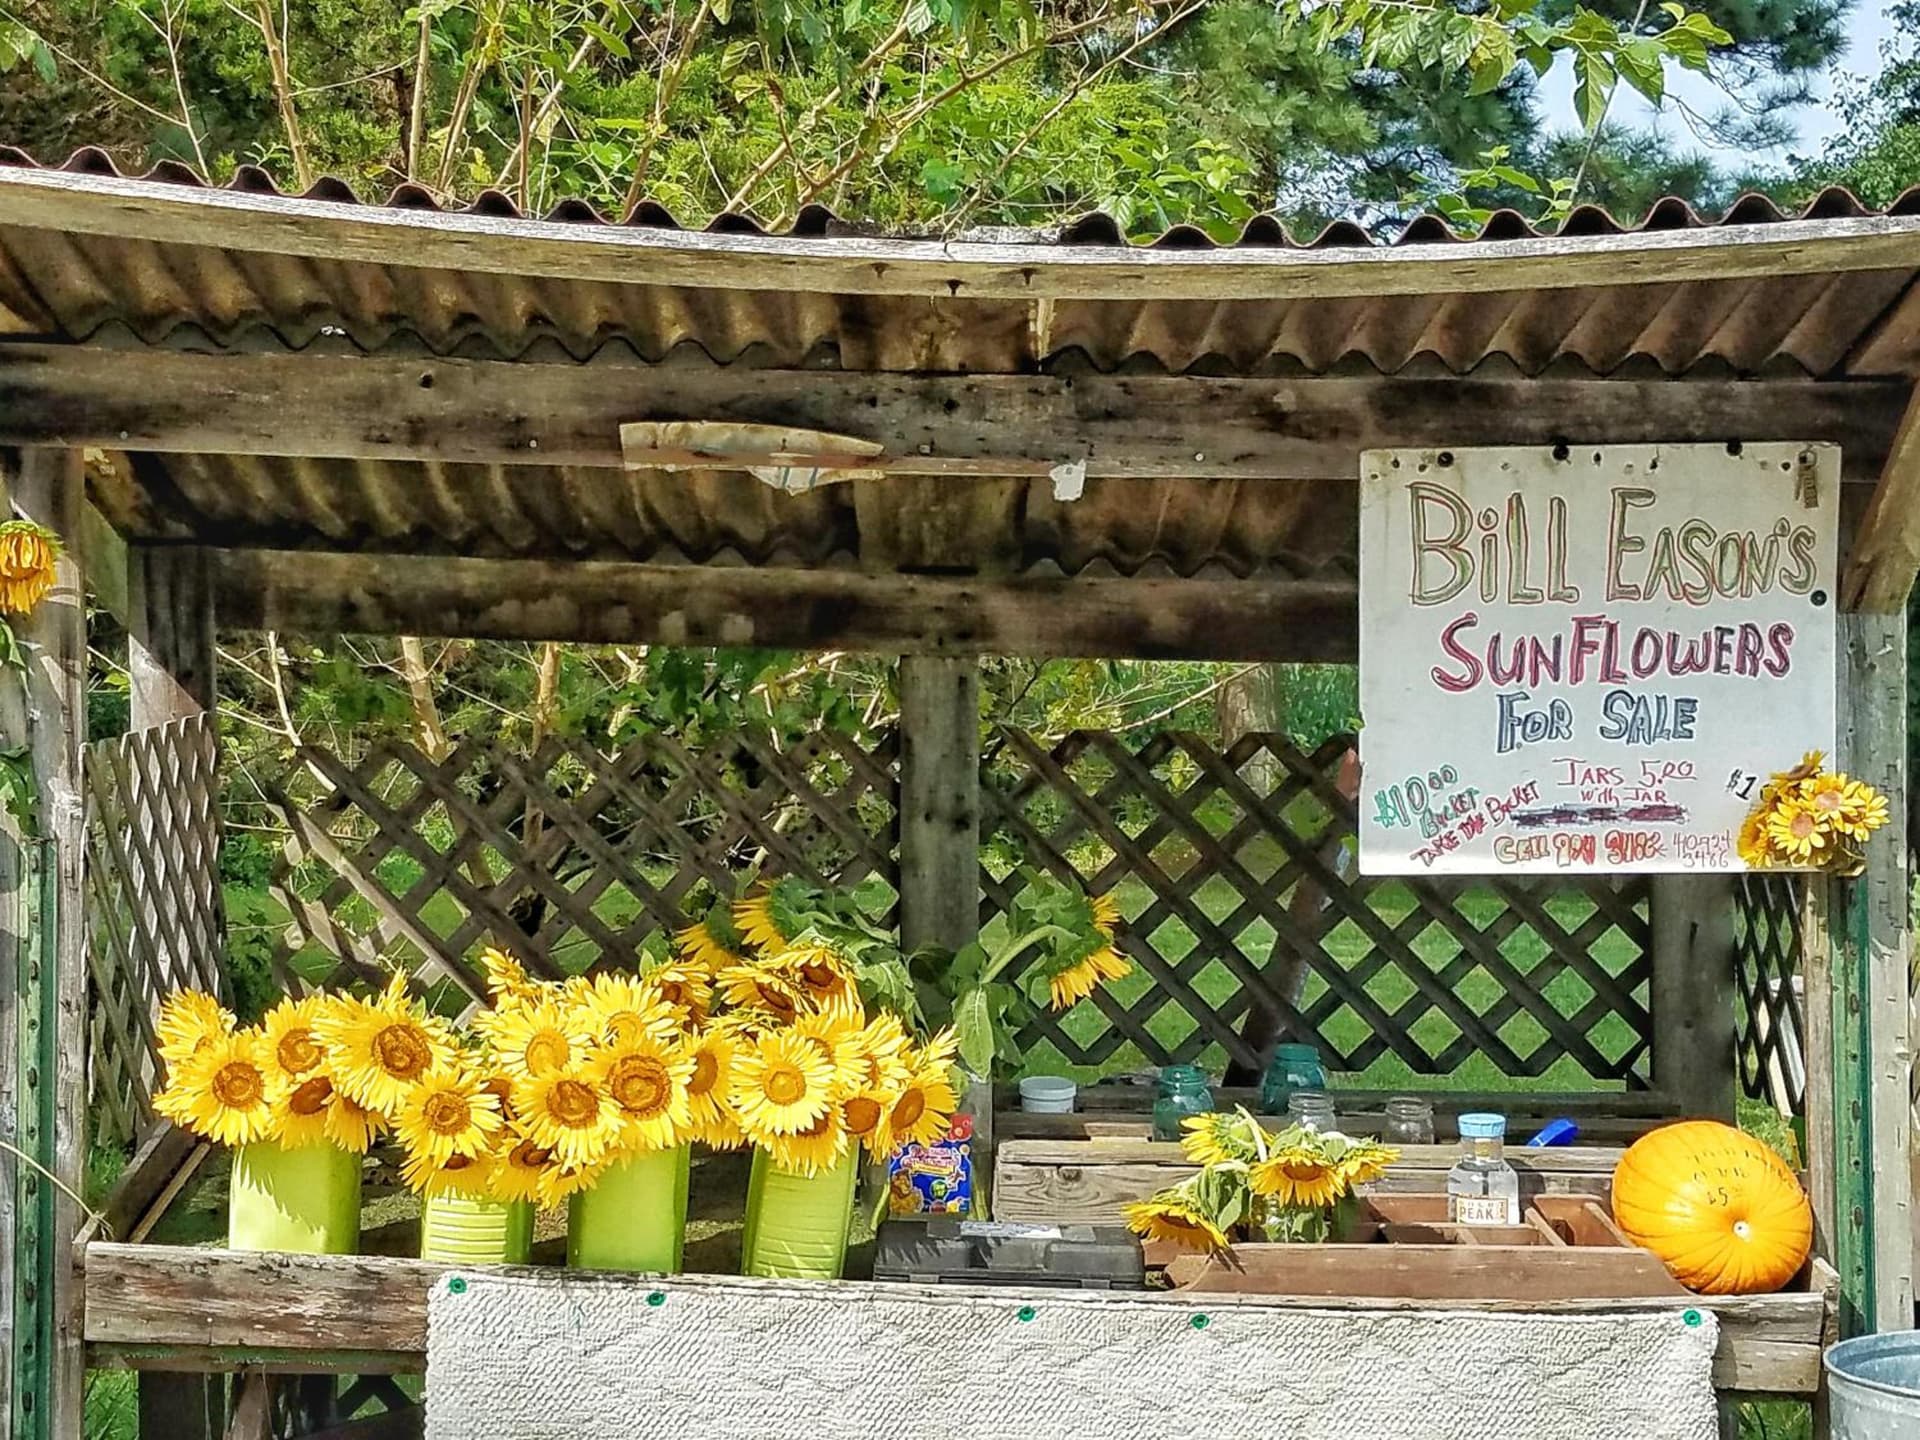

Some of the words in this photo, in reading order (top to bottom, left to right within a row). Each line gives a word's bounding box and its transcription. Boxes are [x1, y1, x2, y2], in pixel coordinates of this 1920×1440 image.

[1431, 611, 1795, 692] SUNFLOWERS
[1495, 692, 1575, 754] FOR
[1599, 689, 1699, 746] SALE
[1552, 758, 1624, 786] JARS
[1725, 768, 1757, 801] $1
[1623, 786, 1667, 804] JAR
[1459, 1206, 1494, 1220] PEAK
